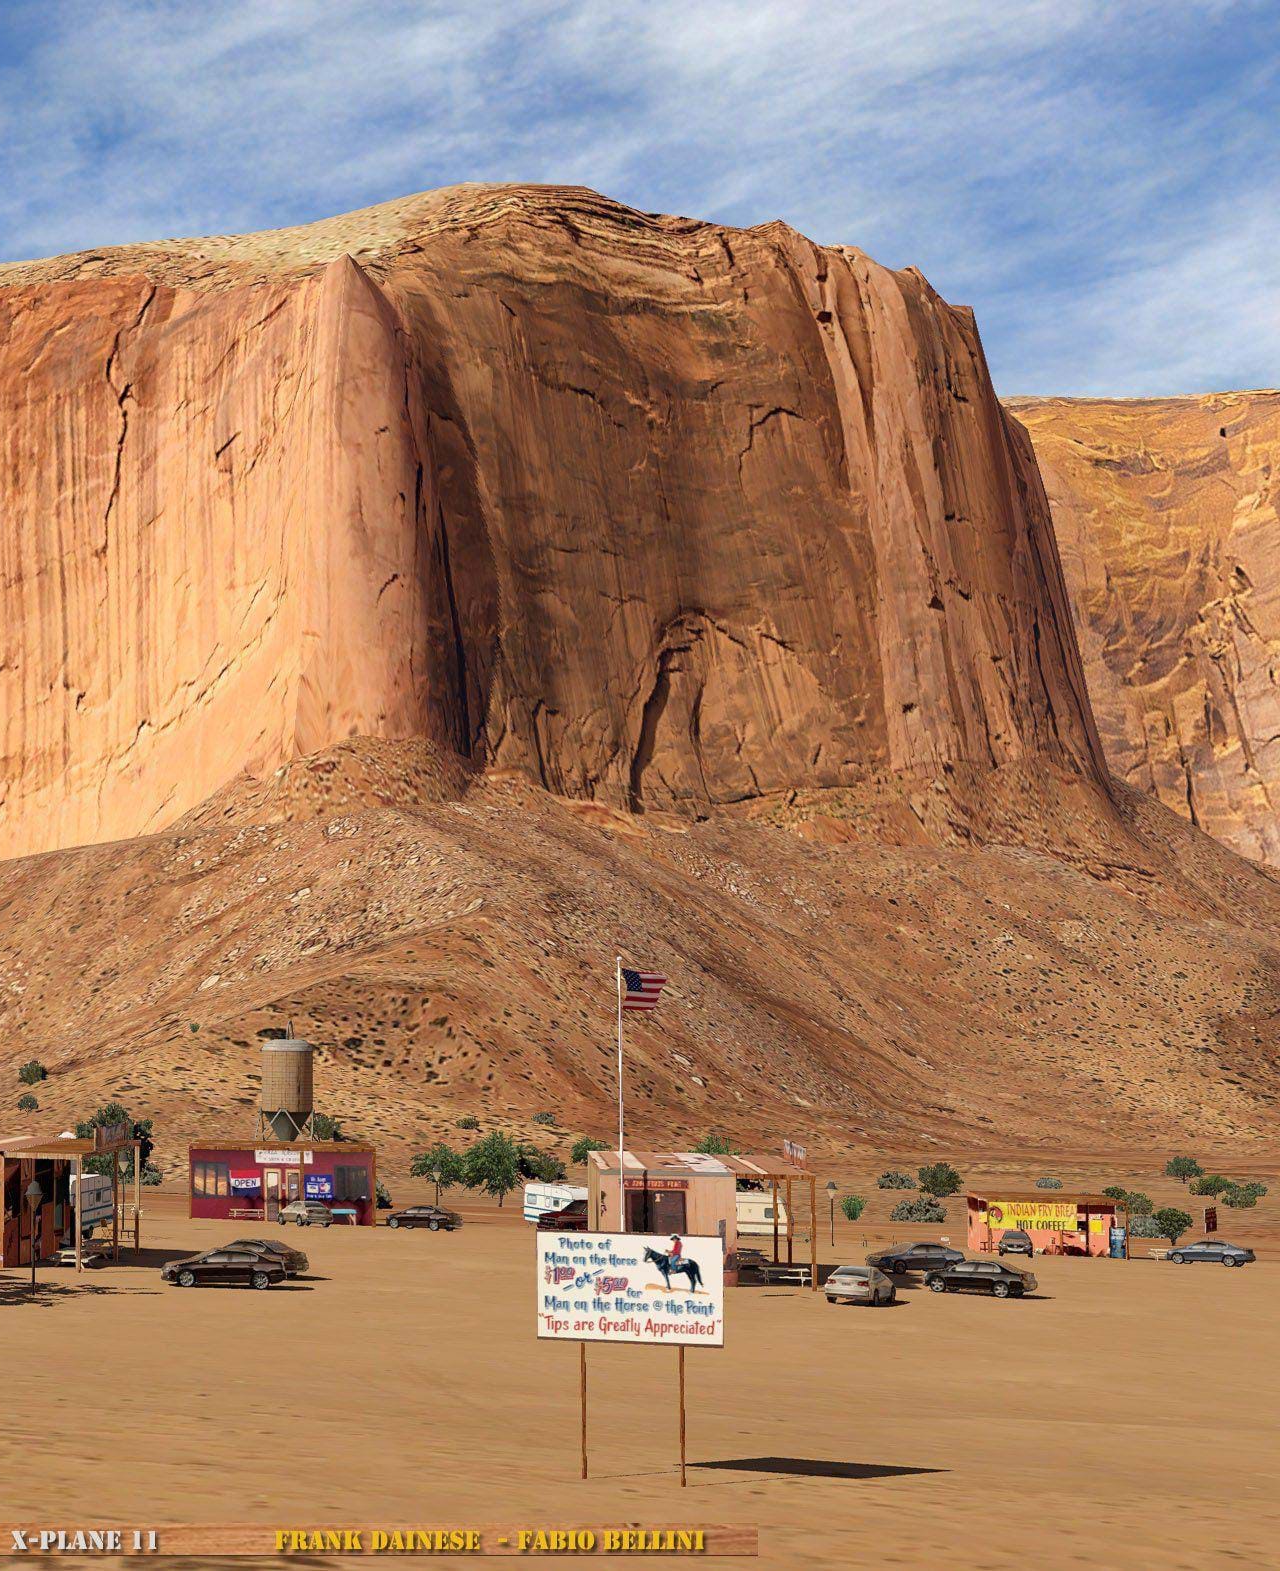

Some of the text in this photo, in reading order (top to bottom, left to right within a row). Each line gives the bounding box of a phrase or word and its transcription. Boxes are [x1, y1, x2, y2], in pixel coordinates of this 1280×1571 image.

[234, 1178, 257, 1188] OPEN
[1007, 1203, 1036, 1217] INDIAN
[1038, 1204, 1054, 1218] FRY
[1016, 1220, 1033, 1230] HOT
[558, 1237, 613, 1251] Photo of
[544, 1251, 638, 1267] Man on the Horse
[626, 1287, 643, 1299] for
[544, 1295, 715, 1317] Man on the Horse @ the Point
[574, 1320, 595, 1331] are
[599, 1316, 641, 1337] Greatly
